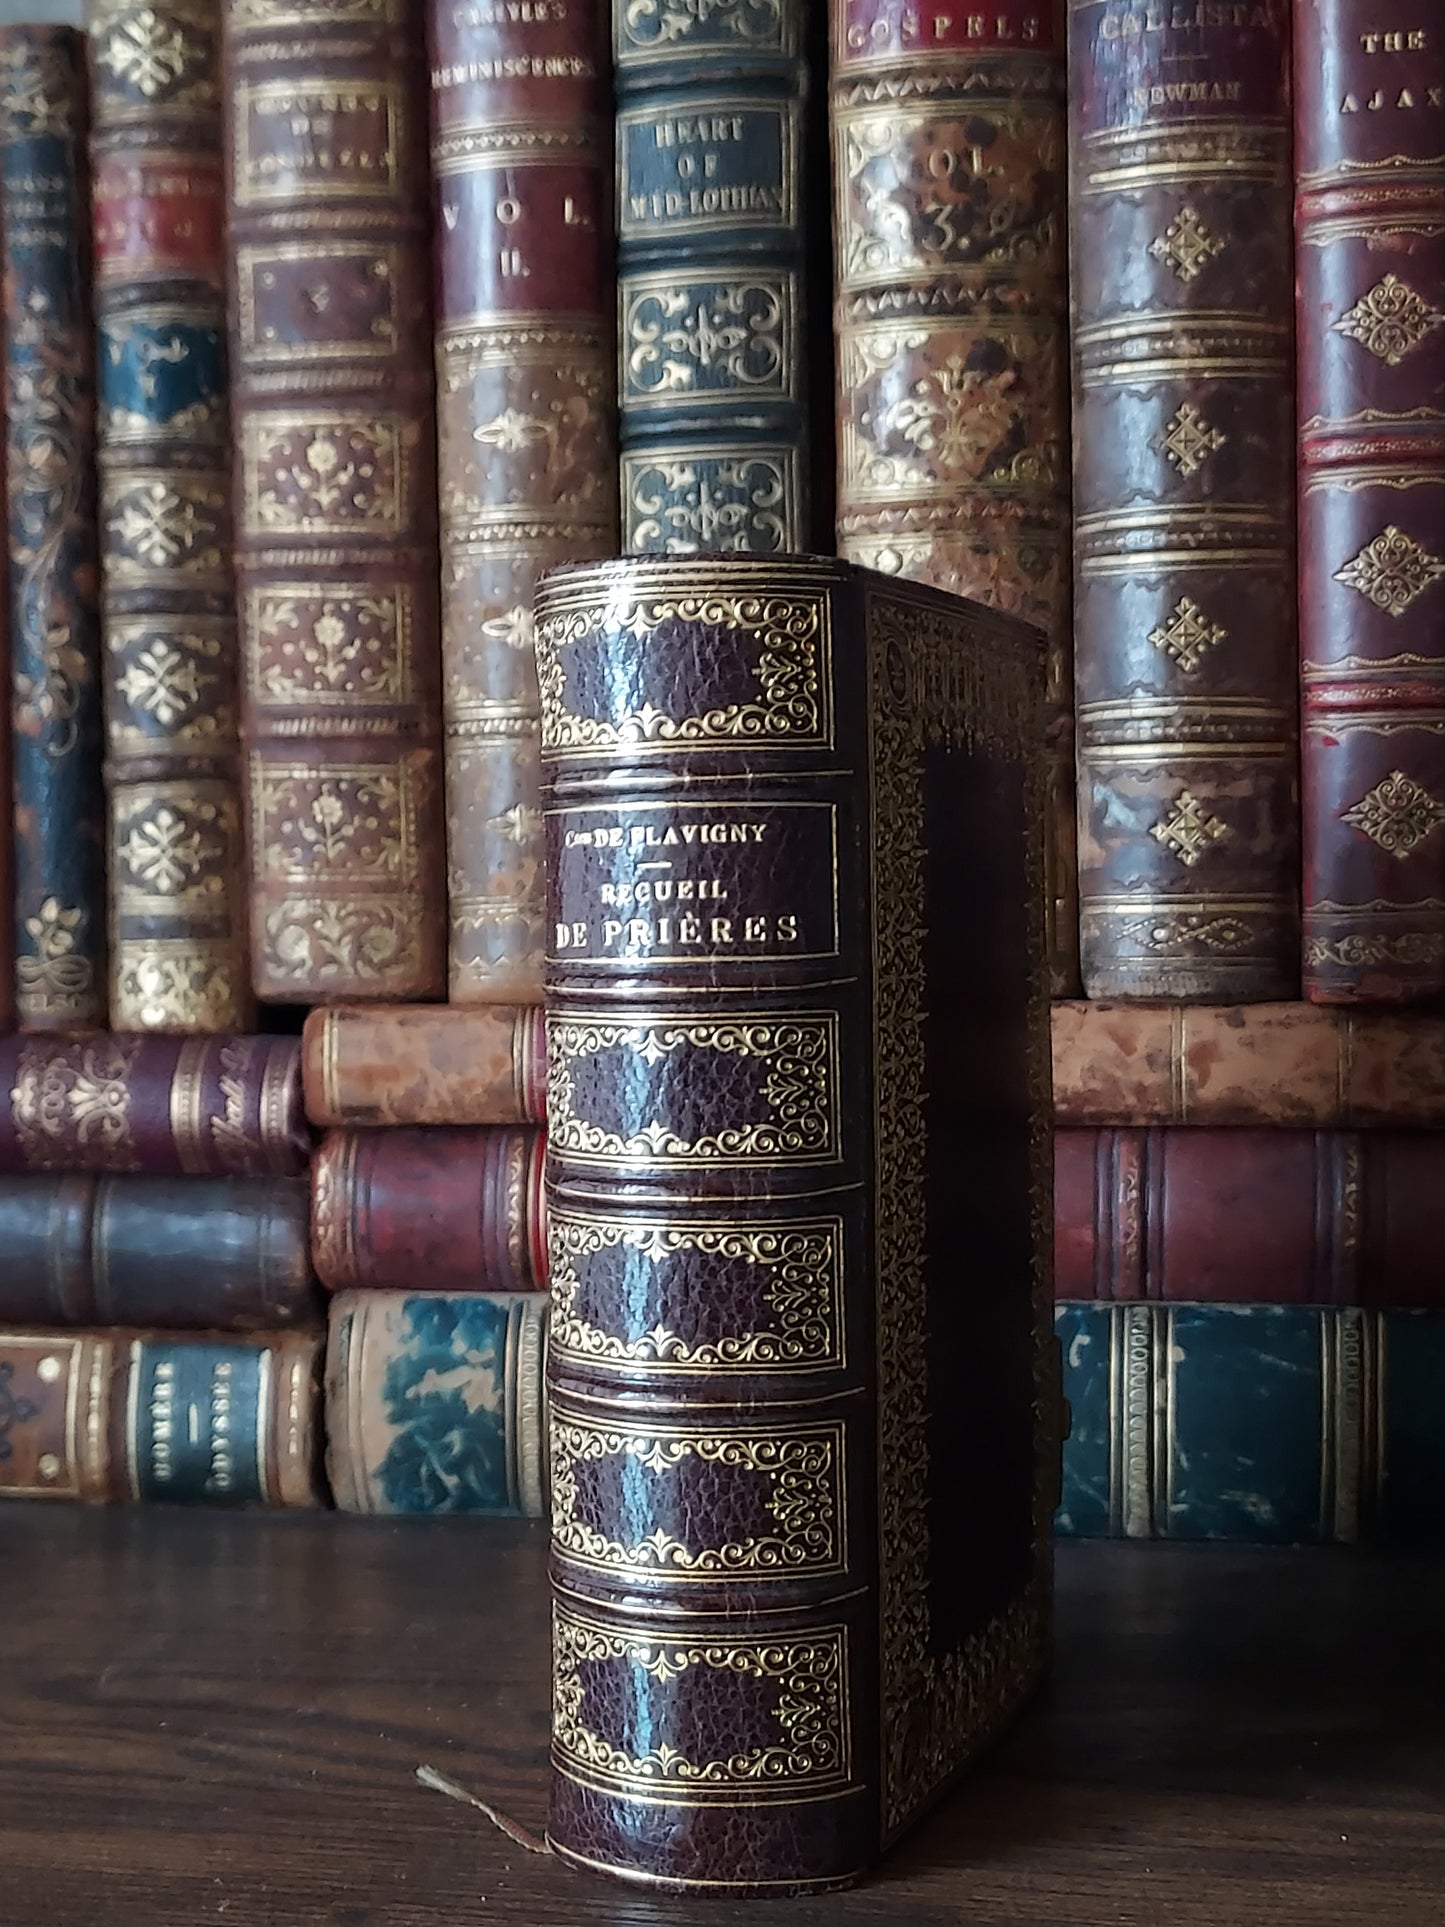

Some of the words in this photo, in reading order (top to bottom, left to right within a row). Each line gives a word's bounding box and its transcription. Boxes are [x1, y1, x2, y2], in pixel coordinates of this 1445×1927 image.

[848, 12, 1039, 48] GOSPELS
[1101, 5, 1268, 40] CALLISTA
[1360, 29, 1425, 53] THE
[1134, 82, 1241, 105] NEWMAN
[1340, 88, 1442, 113] AJAX
[656, 117, 742, 148] HEART
[677, 153, 717, 179] OF
[594, 827, 623, 848] DE
[630, 825, 767, 846] FLAVIGNY
[601, 880, 727, 906] RECUEIL
[556, 922, 588, 949] DE
[603, 911, 798, 946] PRIÈRES
